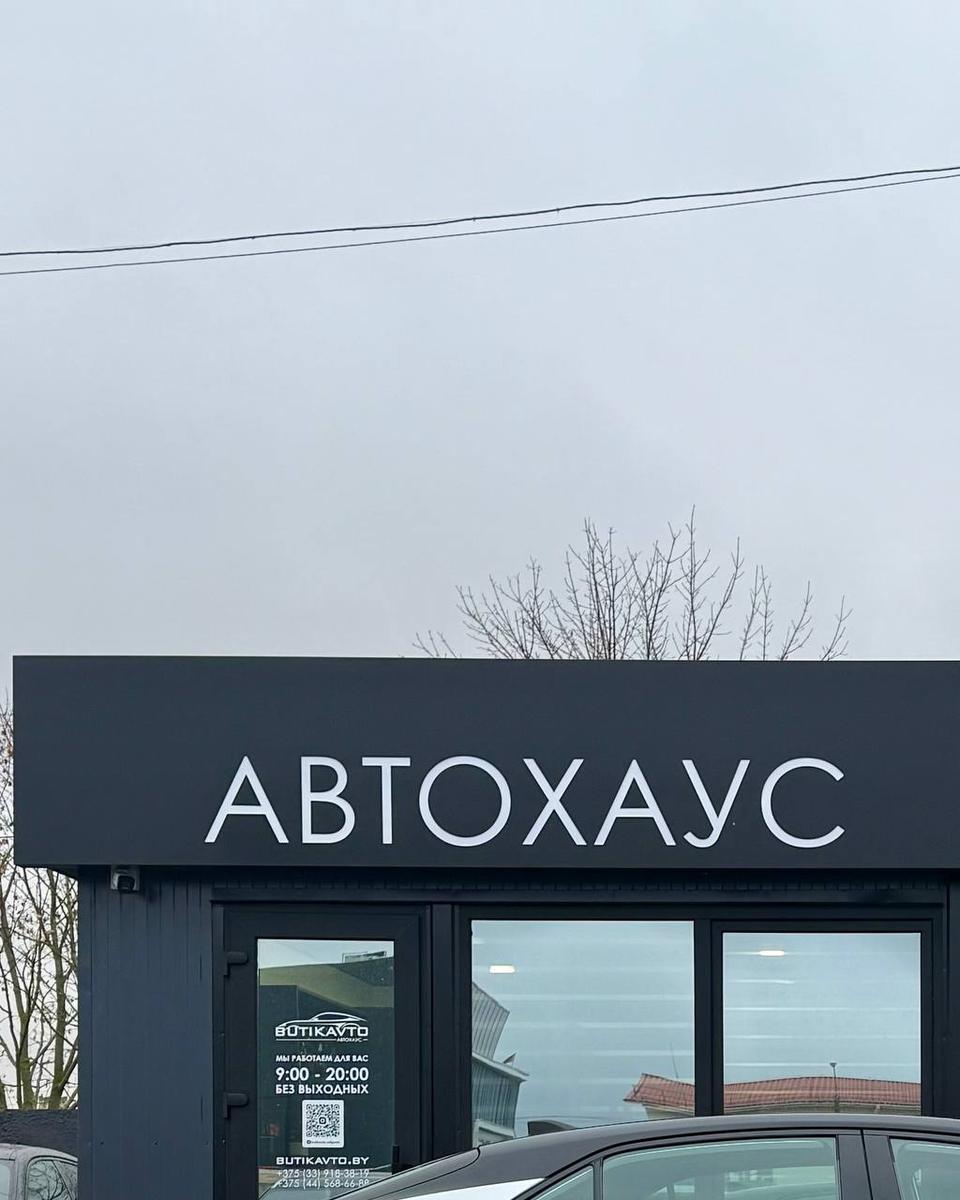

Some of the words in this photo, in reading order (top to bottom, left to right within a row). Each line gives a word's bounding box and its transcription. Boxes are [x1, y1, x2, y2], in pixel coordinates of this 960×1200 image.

[204, 755, 845, 848] АВТОХАУС
[275, 1026, 369, 1037] BUTIKAVTO
[333, 1055, 351, 1063] ДЛЯ
[275, 1067, 310, 1081] 9:00
[325, 1067, 369, 1081] 20:00
[275, 1084, 295, 1094] БЕЗ
[298, 1084, 369, 1095] ВЫХОДНЫХ
[276, 1156, 370, 1165] BUTIKAVTO.BY
[303, 1169, 320, 1180] (33)
